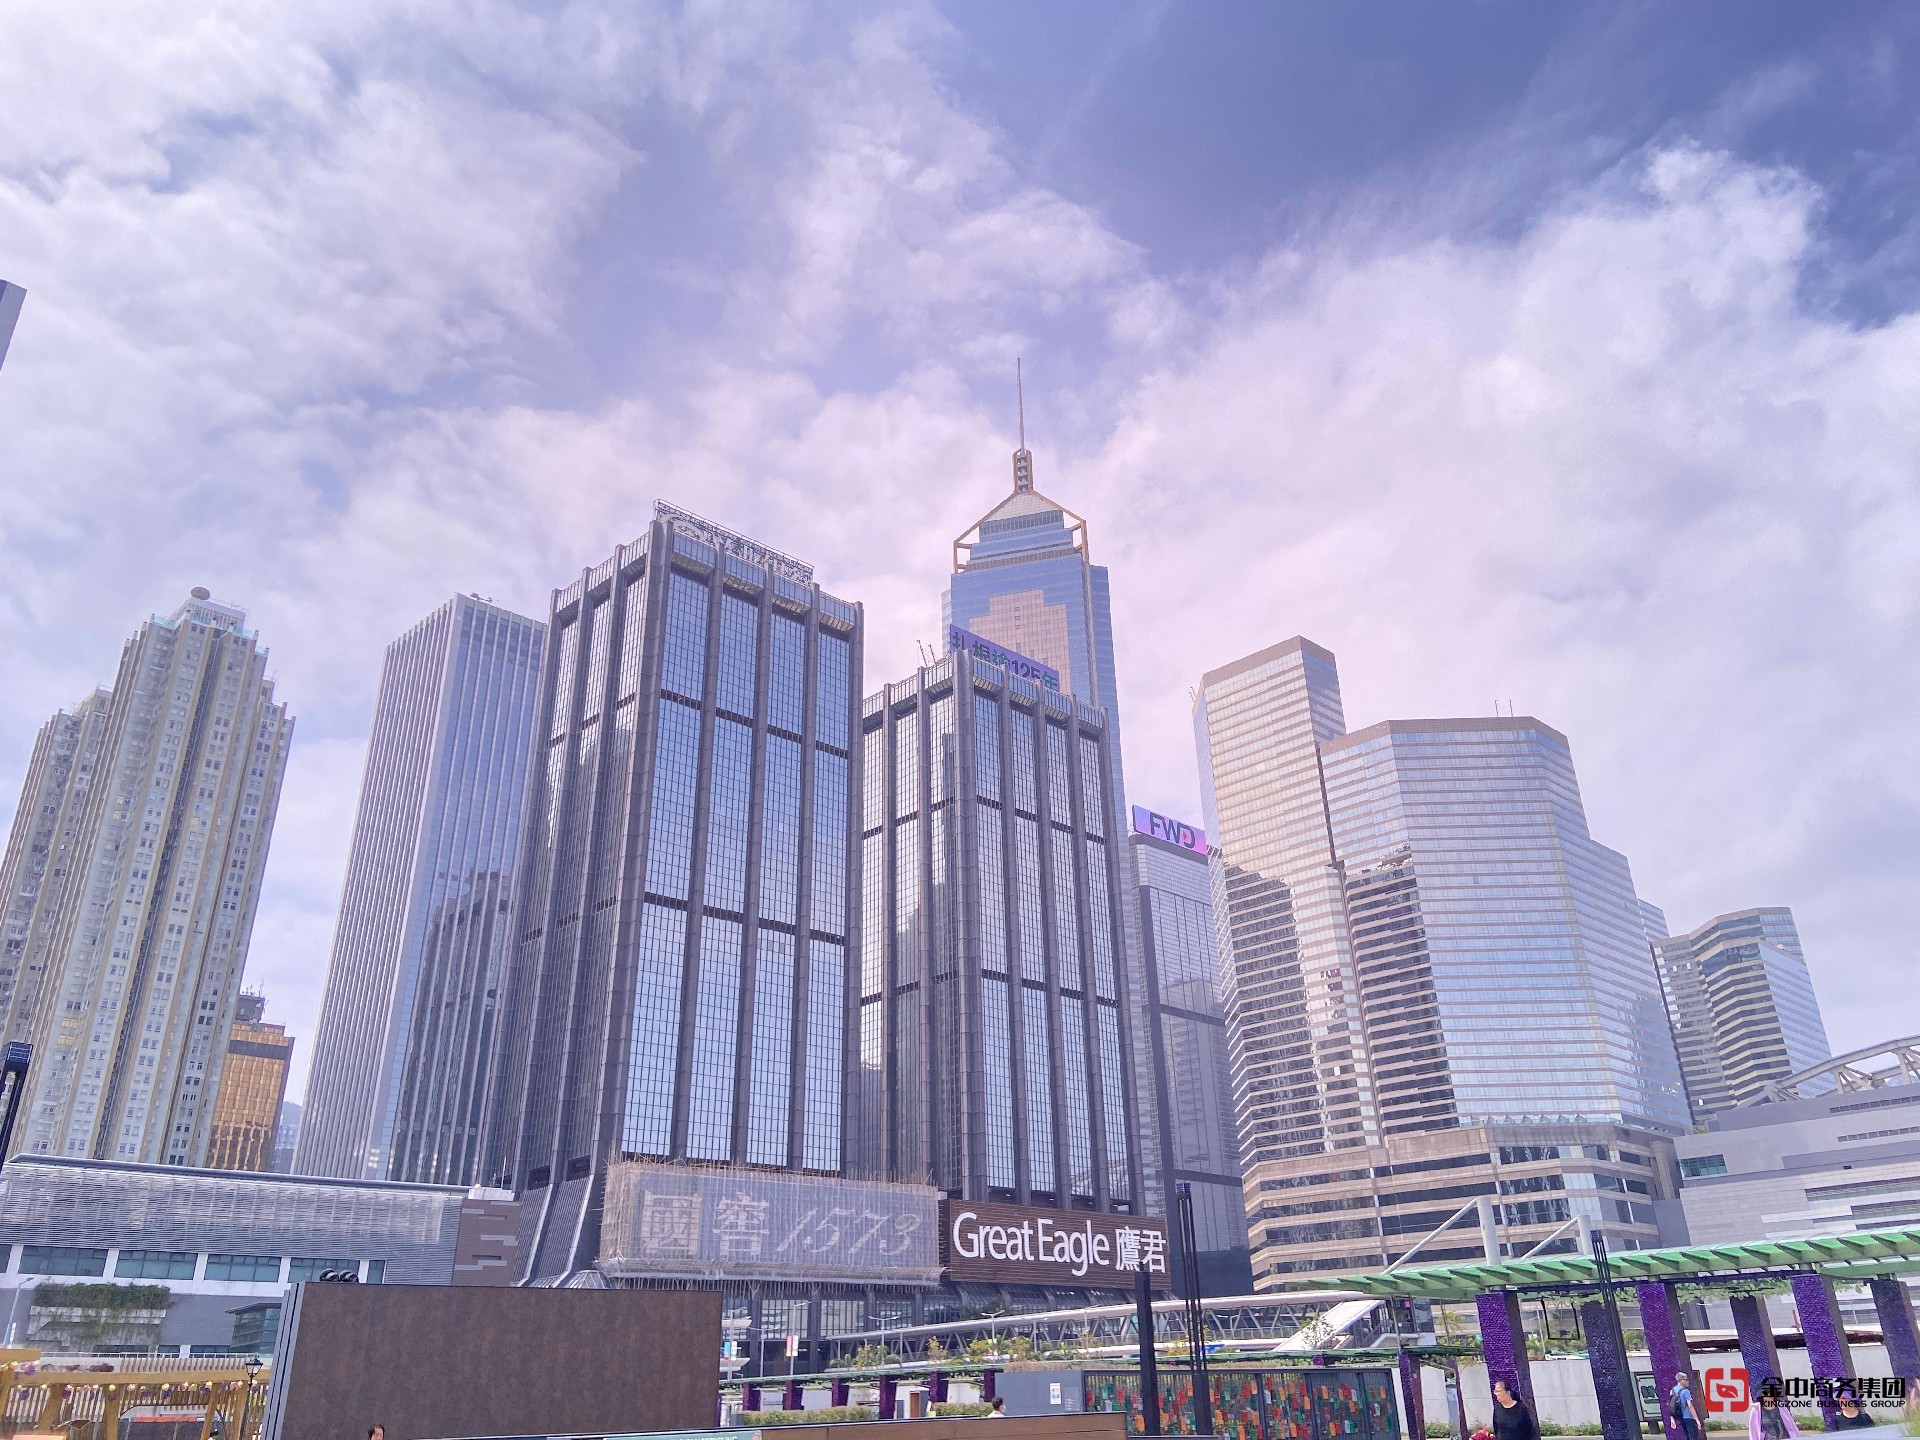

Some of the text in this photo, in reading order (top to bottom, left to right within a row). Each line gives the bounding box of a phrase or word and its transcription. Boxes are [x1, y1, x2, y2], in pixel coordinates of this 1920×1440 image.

[1149, 811, 1195, 849] FWD
[952, 1211, 1167, 1277] Great Eagle 鷹君
